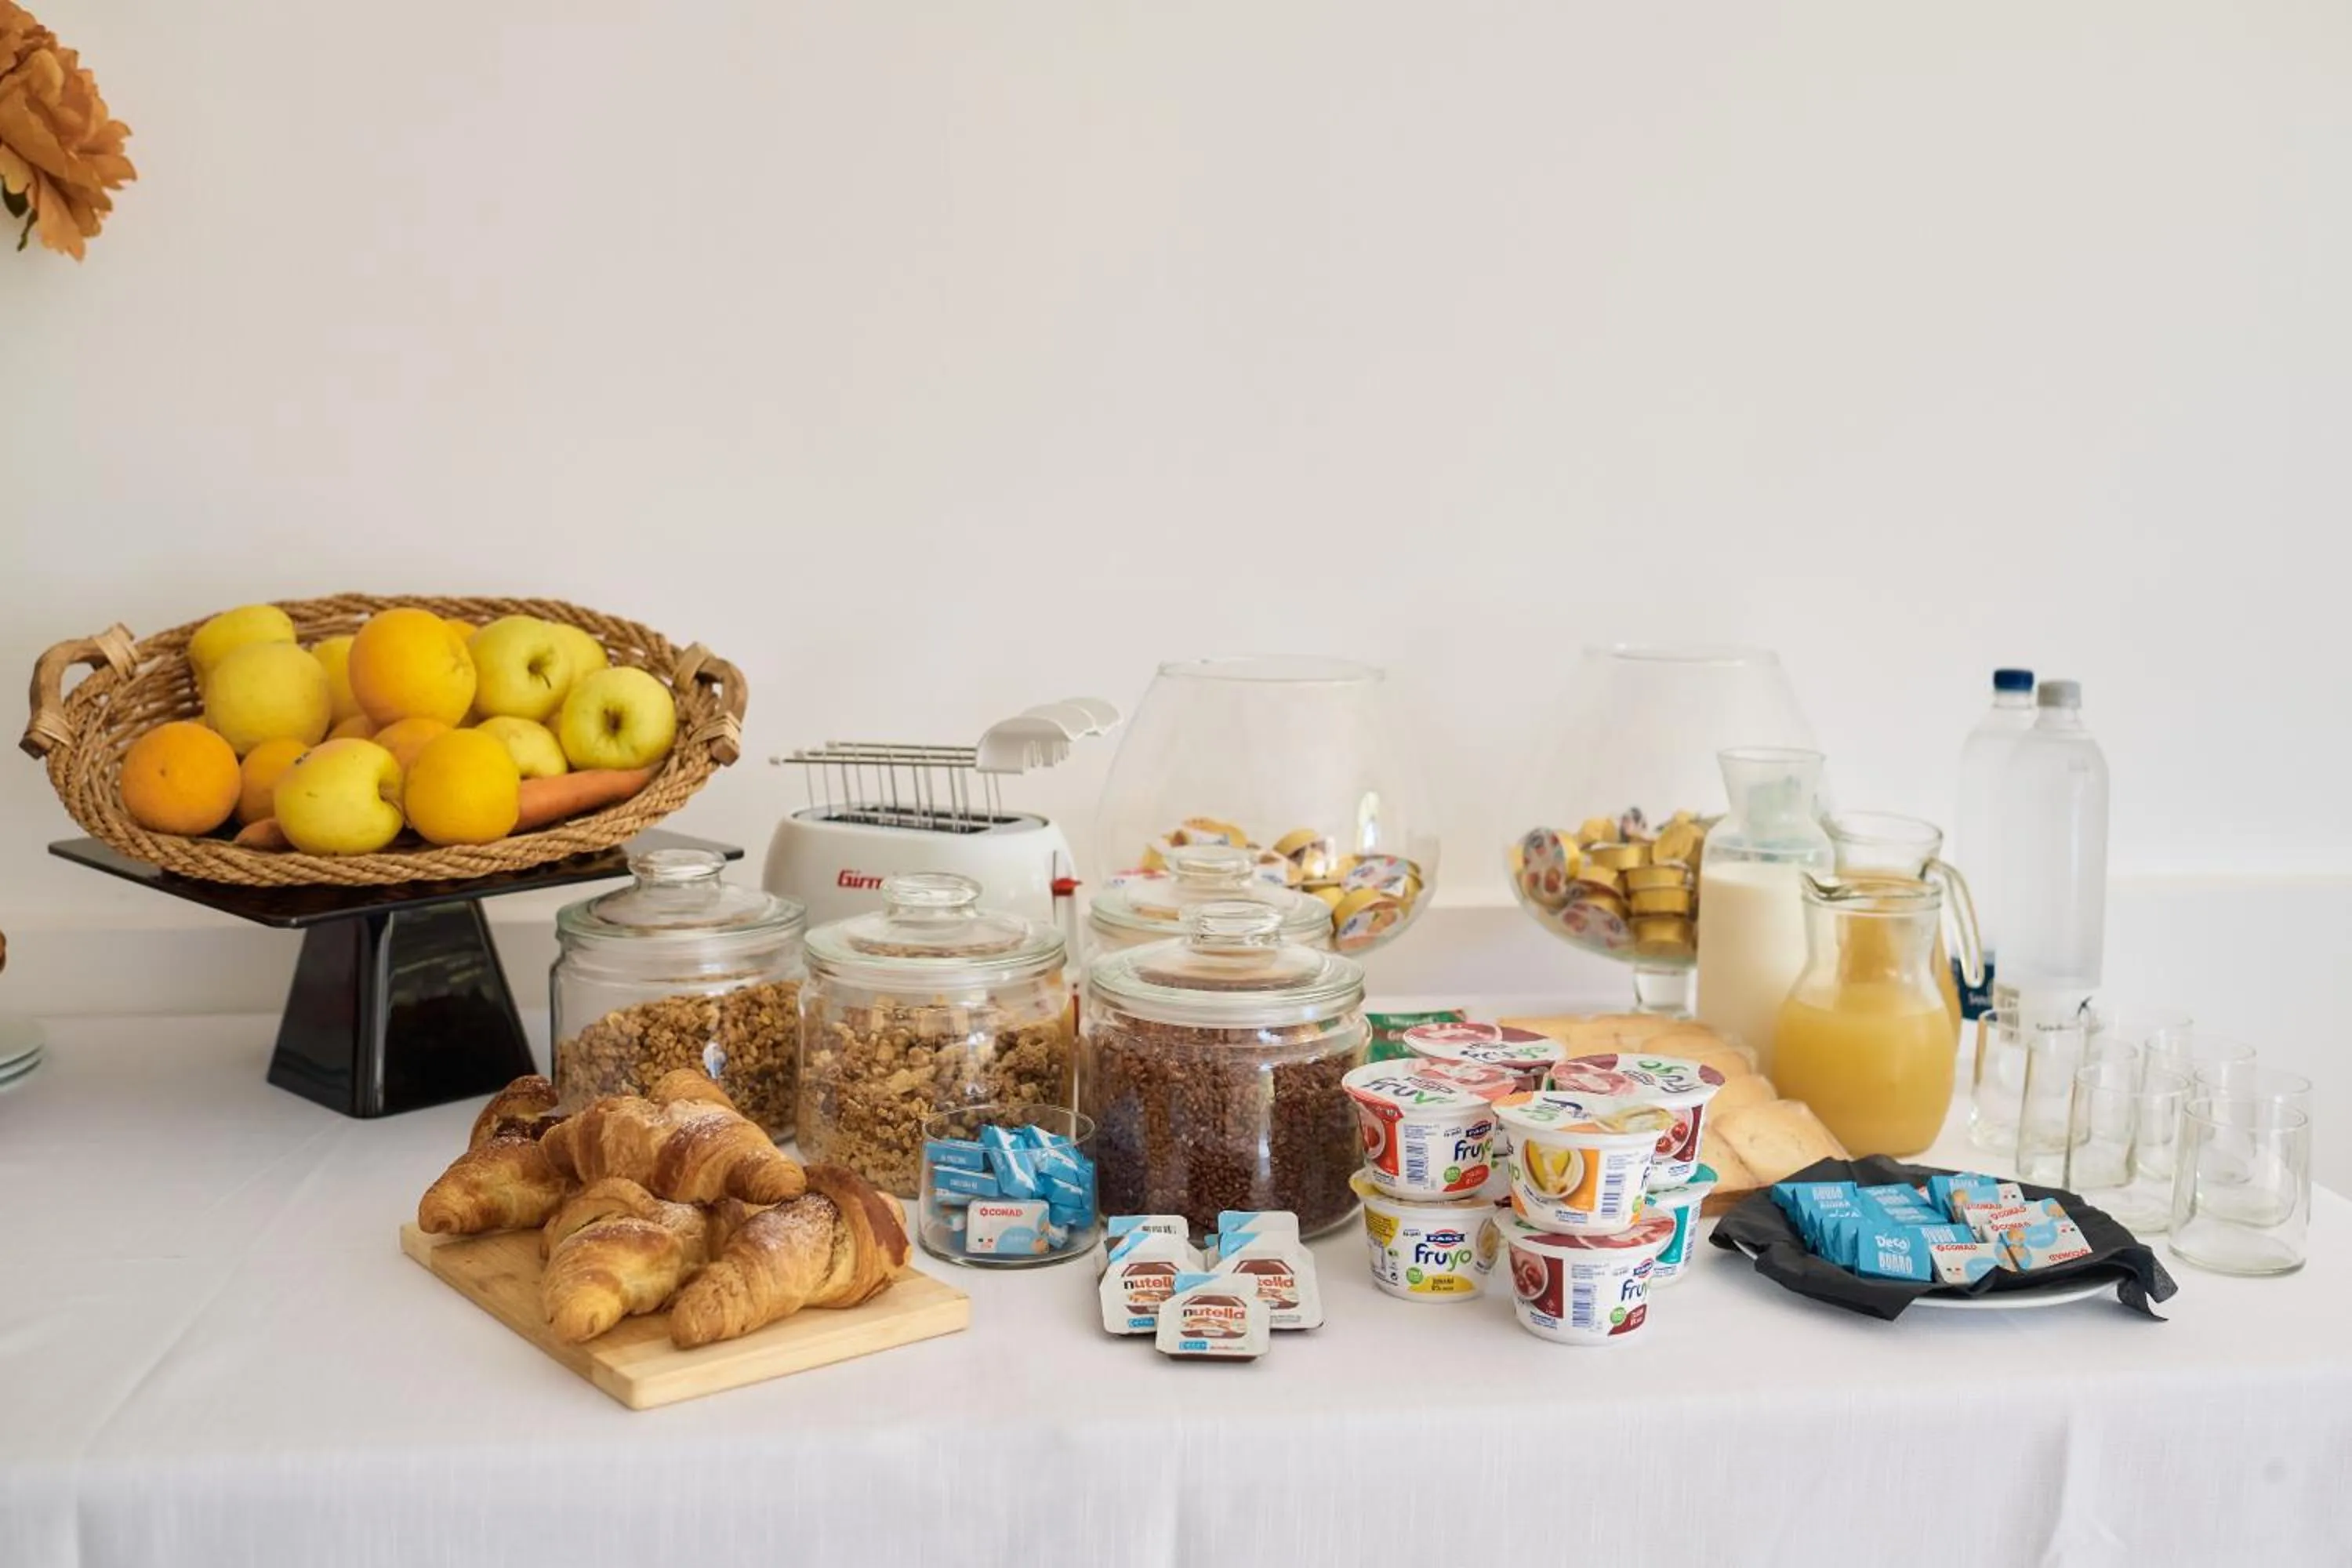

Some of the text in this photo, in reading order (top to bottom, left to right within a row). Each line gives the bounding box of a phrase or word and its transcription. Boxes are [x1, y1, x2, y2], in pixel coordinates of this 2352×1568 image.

[837, 869, 883, 890] Girm
[989, 1208, 1022, 1217] CONAD
[1415, 1243, 1472, 1272] fruyo
[1123, 1276, 1172, 1290] nutell
[1621, 1279, 1647, 1302] fru
[1183, 1306, 1246, 1319] nutella
